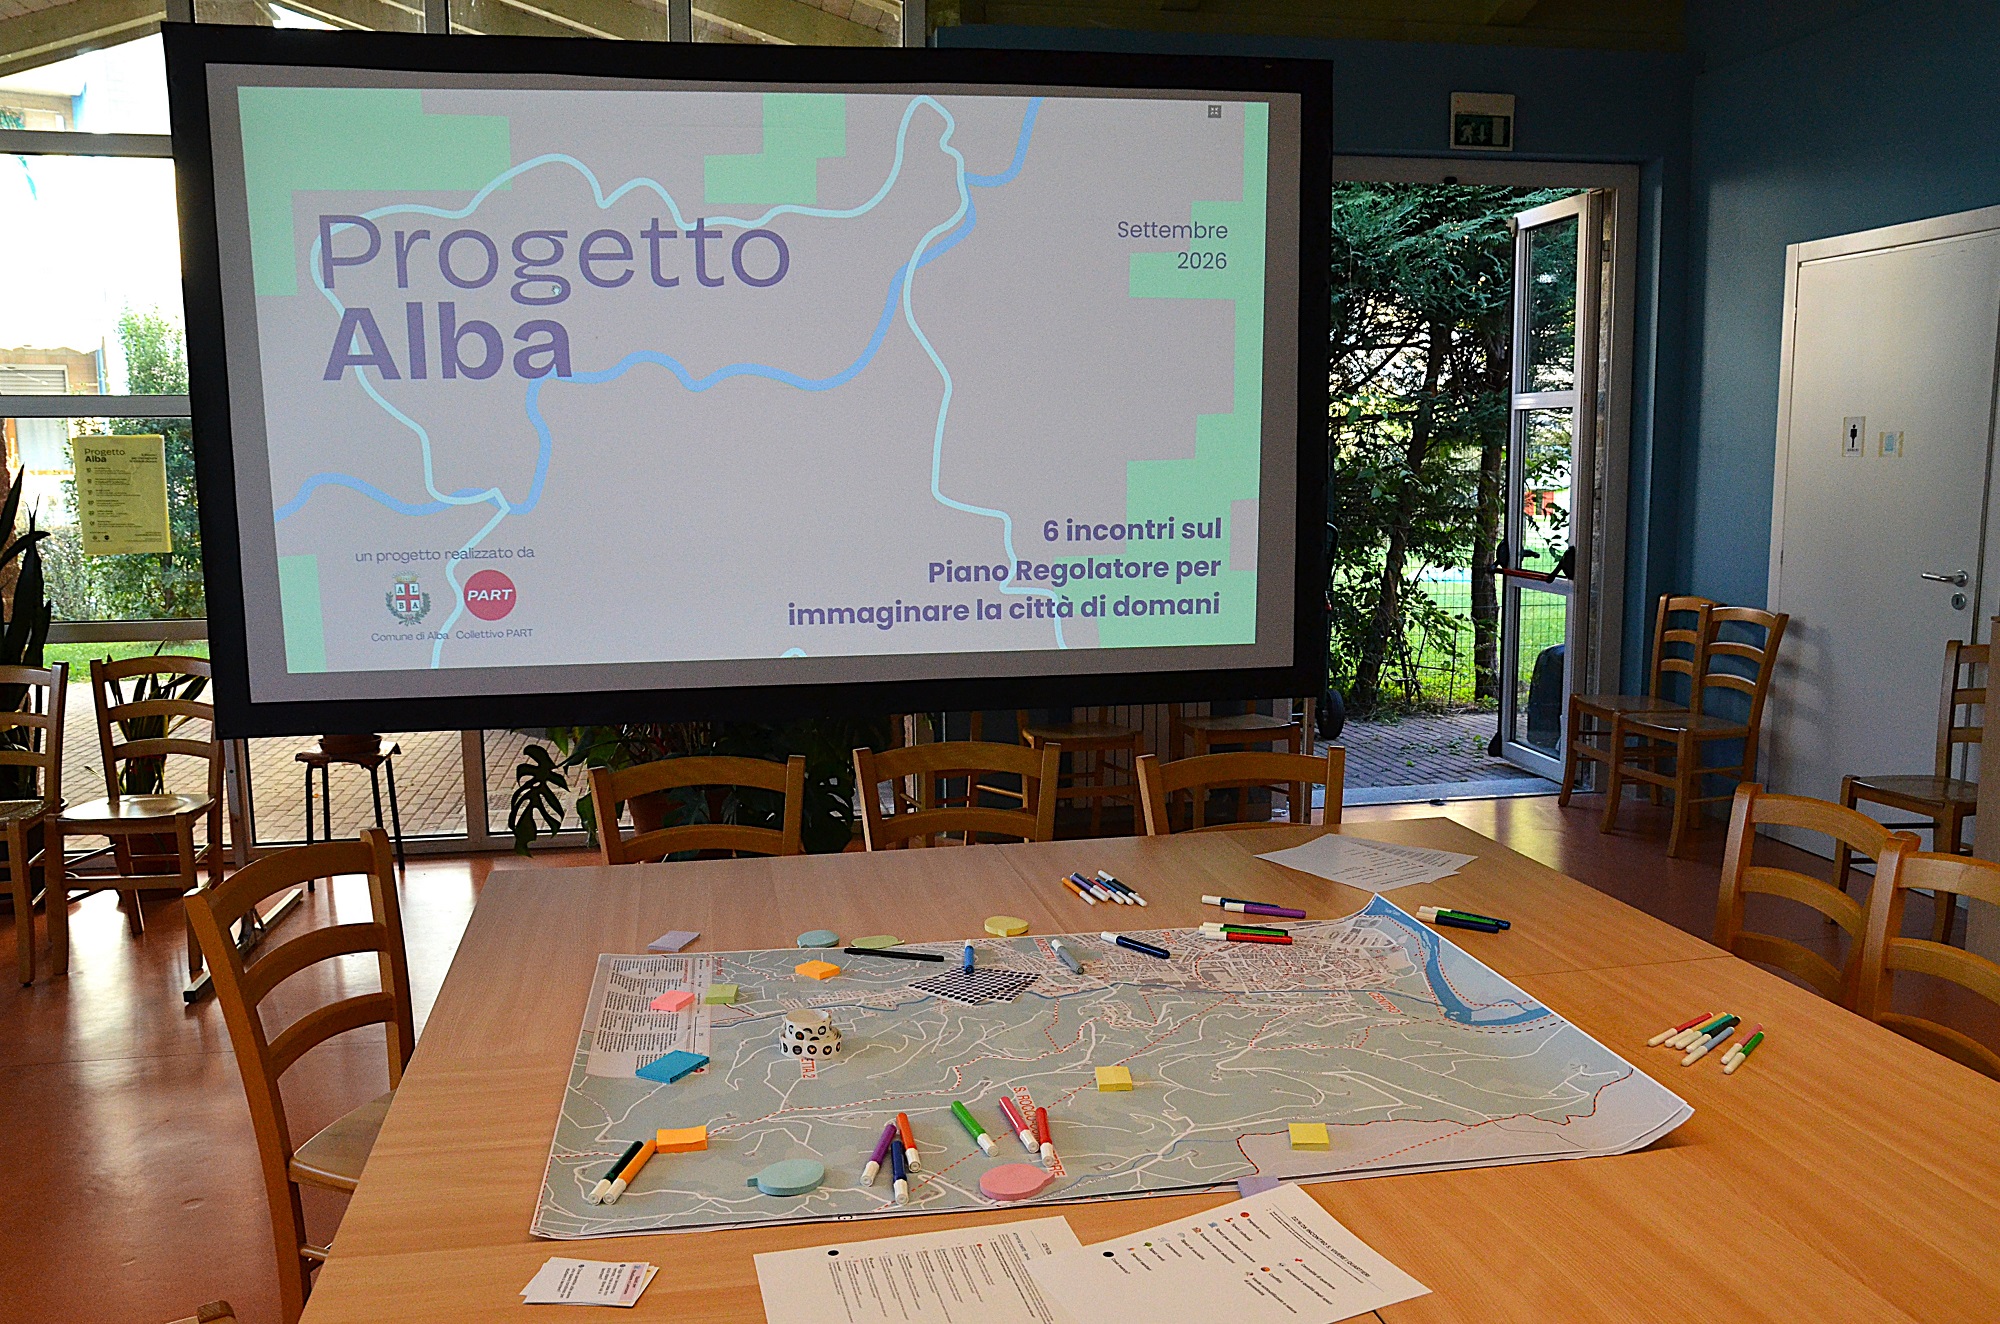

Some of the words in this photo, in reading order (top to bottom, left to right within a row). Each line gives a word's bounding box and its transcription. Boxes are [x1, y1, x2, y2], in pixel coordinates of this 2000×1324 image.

[1117, 221, 1228, 239] Settembre
[318, 214, 790, 306] Progetto
[1177, 252, 1228, 270] 2026
[323, 301, 573, 381] Alba
[84, 448, 126, 457] Progetto
[1043, 520, 1059, 542] 6
[1066, 516, 1175, 541] incontri
[1181, 517, 1222, 540] sul
[355, 552, 373, 563] un
[376, 549, 441, 564] progetto
[445, 547, 513, 560] realizzato
[517, 546, 535, 558] da
[928, 559, 1009, 583] Piano
[1016, 557, 1169, 587] Regolatore
[1175, 559, 1222, 584] per
[467, 589, 513, 601] PART
[788, 599, 970, 630] immaginare
[976, 598, 1001, 620] la
[1008, 595, 1074, 620] città
[1080, 594, 1107, 618] di
[1113, 591, 1220, 617] domani
[371, 632, 414, 642] Comune
[416, 631, 425, 641] di
[427, 630, 450, 640] Alba
[456, 629, 504, 640] Collettivo
[506, 628, 533, 638] PART
[1368, 992, 1401, 1013] CENTRO
